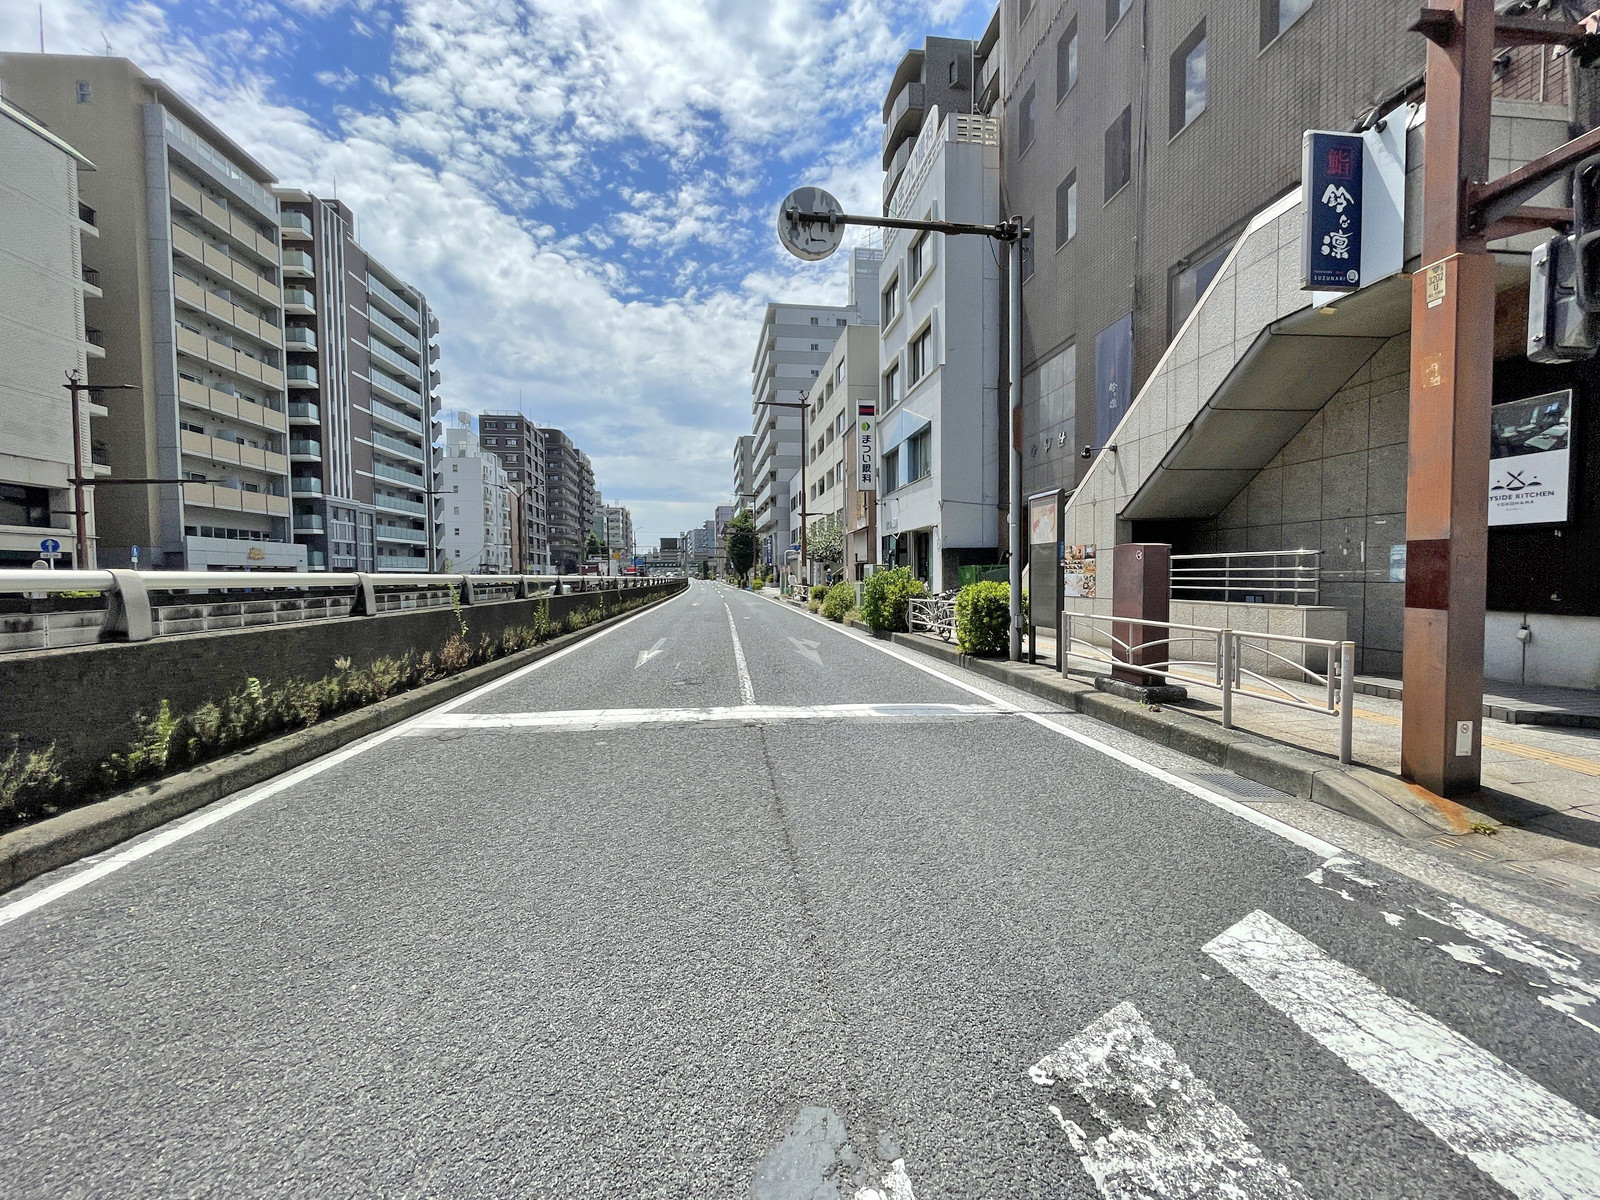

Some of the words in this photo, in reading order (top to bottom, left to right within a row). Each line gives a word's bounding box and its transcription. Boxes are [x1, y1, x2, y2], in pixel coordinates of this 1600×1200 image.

[861, 434, 872, 484] まつい眼科
[1515, 491, 1555, 499] KITCHEN
